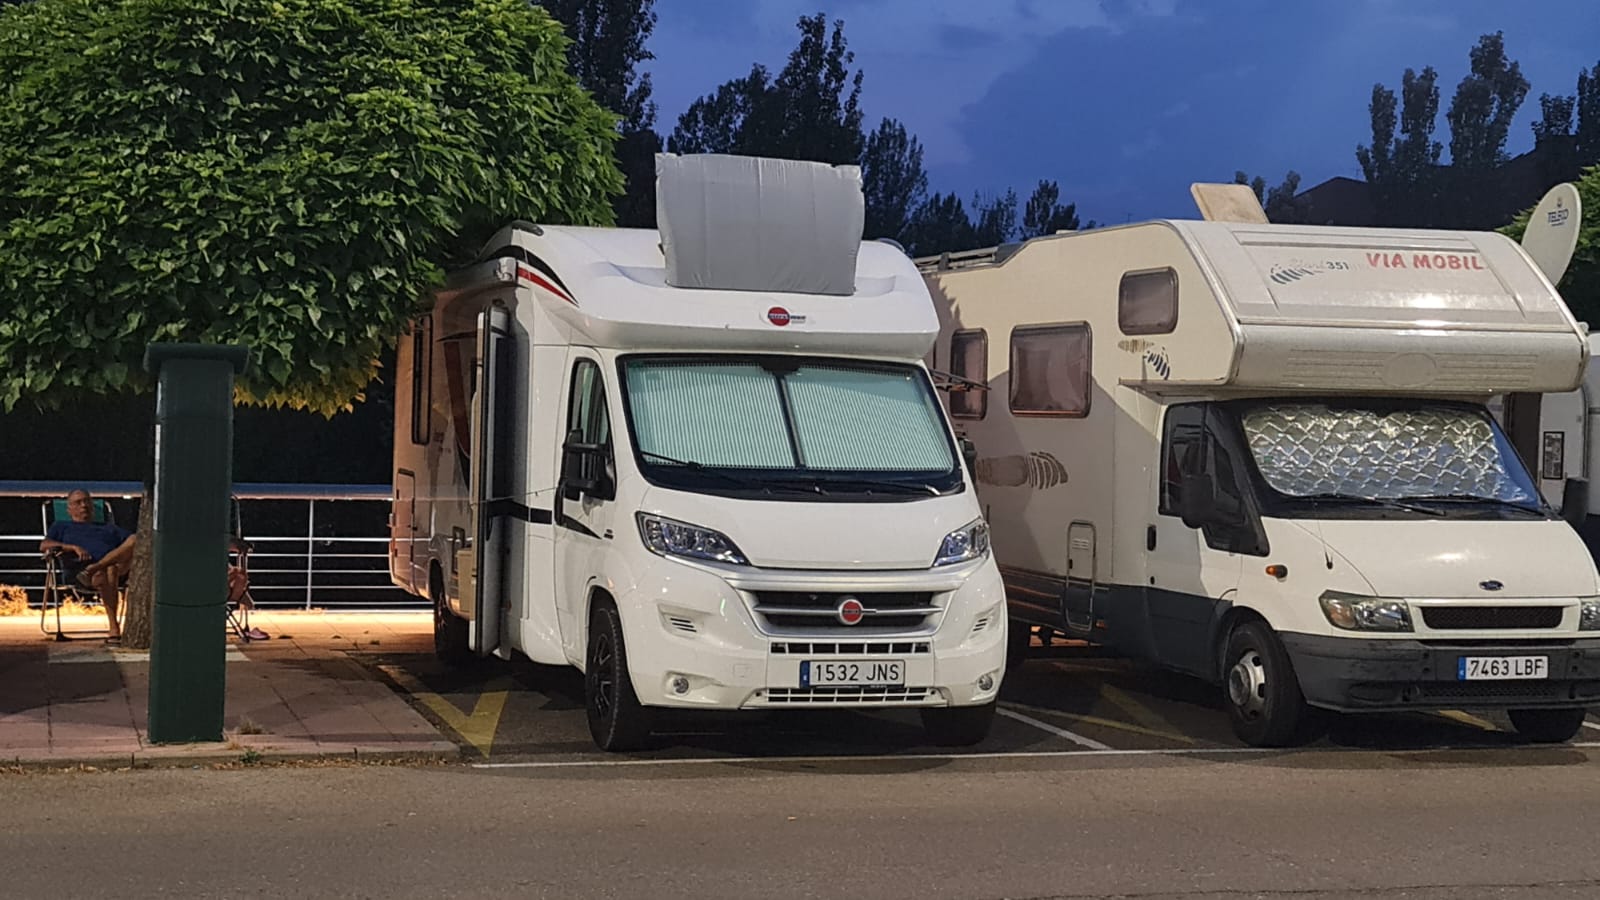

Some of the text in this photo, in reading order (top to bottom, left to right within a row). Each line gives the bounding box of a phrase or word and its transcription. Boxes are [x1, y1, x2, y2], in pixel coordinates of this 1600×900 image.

[1326, 261, 1349, 270] 351
[1366, 253, 1484, 270] VIA MOBIL
[816, 664, 899, 681] 1532 JNS
[1470, 659, 1545, 677] 7463 LBF
